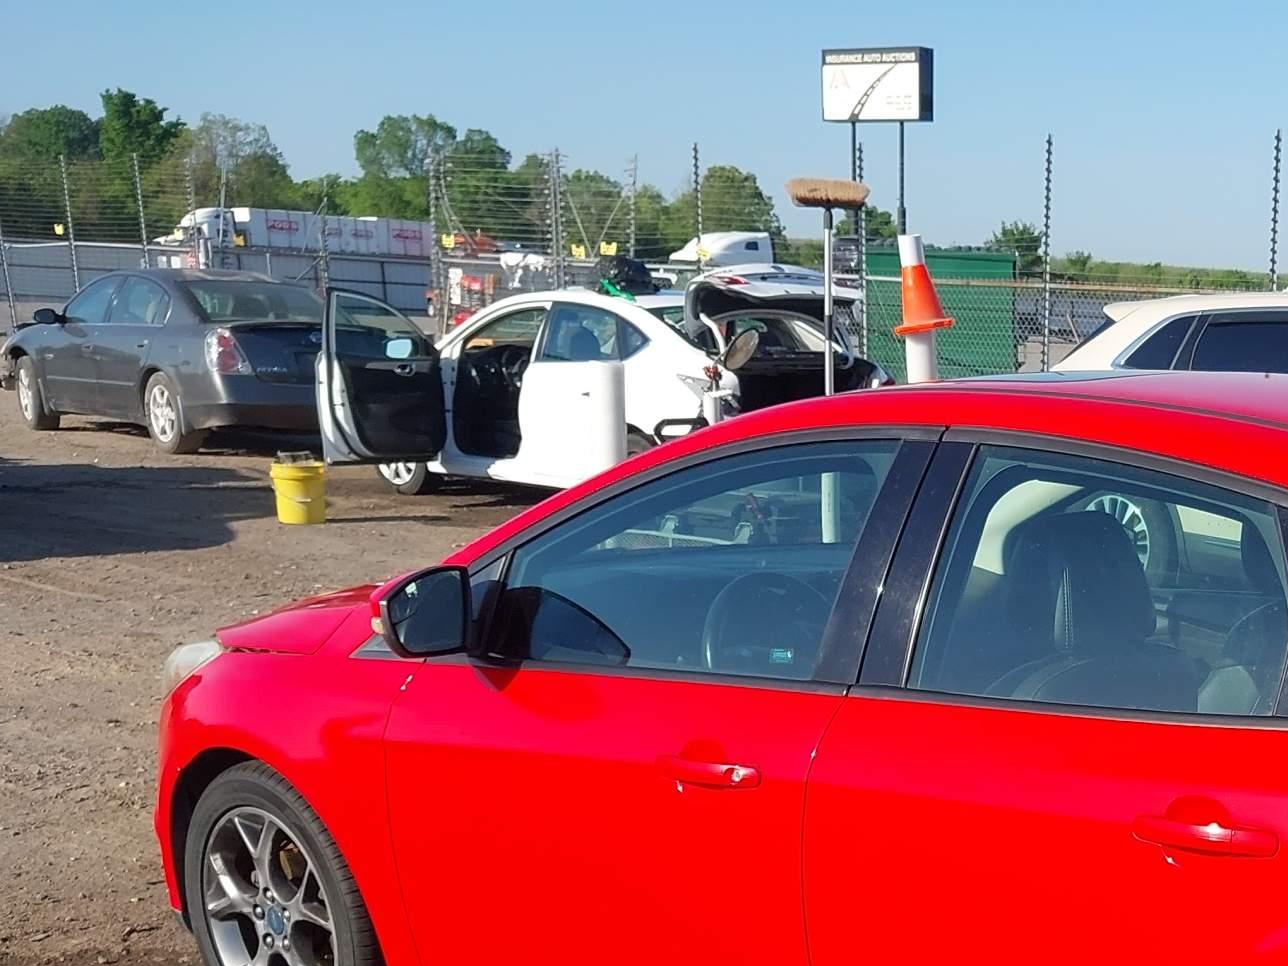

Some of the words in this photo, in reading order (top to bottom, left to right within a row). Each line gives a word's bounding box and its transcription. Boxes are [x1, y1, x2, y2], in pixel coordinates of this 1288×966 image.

[825, 54, 863, 64] INSURANCE
[864, 53, 881, 63] AUTO
[882, 52, 916, 62] AUCTIONS
